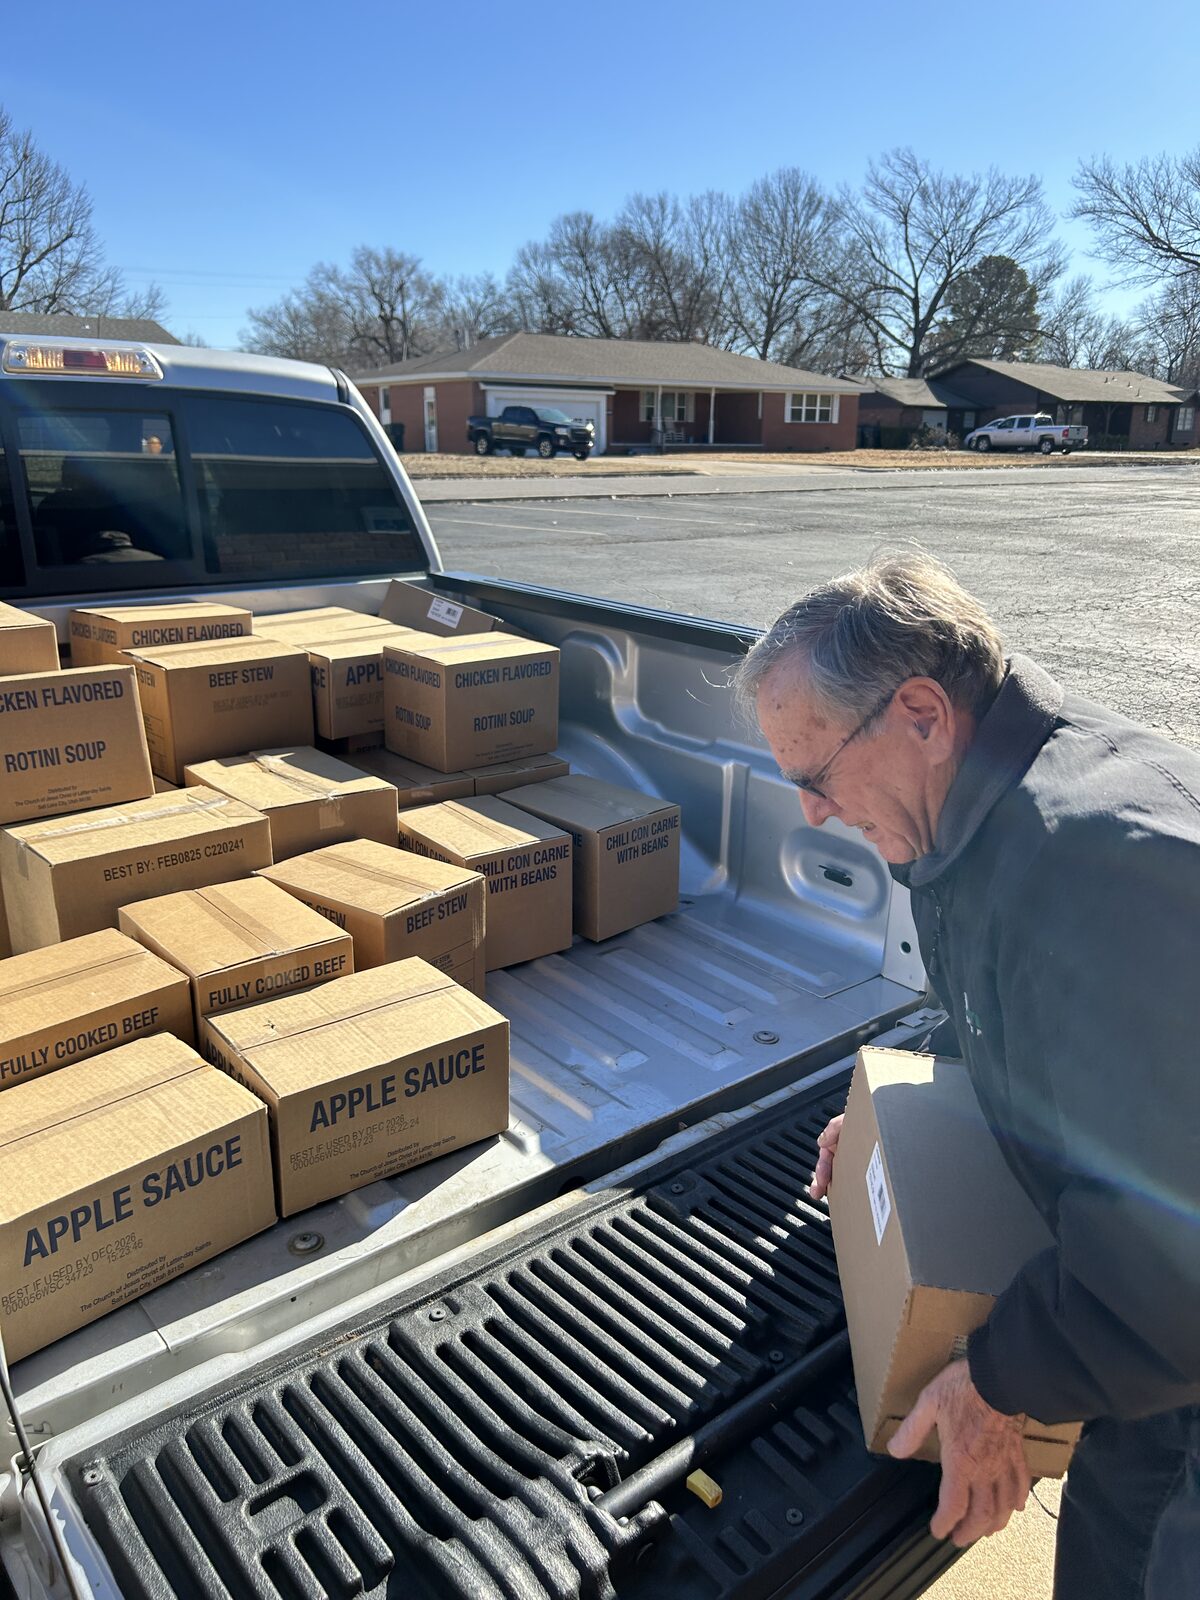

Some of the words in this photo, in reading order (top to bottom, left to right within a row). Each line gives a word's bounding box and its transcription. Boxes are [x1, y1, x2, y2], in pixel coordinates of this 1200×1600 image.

[71, 621, 91, 640] CHICKEN
[132, 627, 184, 646] CHICKEN
[187, 623, 243, 641] FLAVORED
[209, 671, 238, 688] BEEF
[242, 666, 274, 684] STEW
[346, 662, 384, 687] APPL
[385, 658, 409, 679] CHICKEN
[410, 665, 441, 688] FLAVORED
[455, 670, 499, 688] CHICKEN
[502, 661, 551, 682] FLAVORED
[42, 680, 124, 707] FLAVORED
[395, 705, 415, 725] ROTINI
[416, 713, 432, 732] SOUP
[474, 713, 507, 732] ROTINI
[509, 708, 535, 725] SOUP
[5, 748, 61, 773] ROTINI
[65, 741, 107, 764] SOUP
[606, 832, 629, 851] CHILI
[631, 824, 650, 842] CON
[651, 814, 679, 836] CARNE
[103, 864, 132, 882] BEST
[137, 860, 156, 875] BY:
[157, 850, 202, 869] FEB0825
[204, 838, 244, 858] C220241
[475, 859, 504, 877] CHILI
[507, 853, 530, 871] CON
[533, 844, 569, 865] CARNE
[616, 847, 638, 865] WITH
[640, 838, 669, 857] BEANS
[489, 873, 517, 894] WITH
[521, 865, 557, 886] BEANS
[406, 911, 434, 934] BEEF
[438, 893, 468, 921] STEW
[208, 982, 250, 1007] FULLY
[255, 964, 310, 994] COOKED
[314, 955, 346, 977] BEEF
[0, 1046, 49, 1079] FULLY
[54, 1022, 118, 1059] COOKED
[122, 1007, 159, 1034] BEEF
[310, 1075, 397, 1133] APPLE
[404, 1044, 486, 1098] SAUCE
[290, 1149, 313, 1164] BEST
[315, 1143, 324, 1154] IF
[326, 1134, 350, 1150] USED
[352, 1130, 365, 1141] BY
[366, 1121, 384, 1135] DEC
[24, 1185, 133, 1267] APPLE
[142, 1135, 242, 1207] SAUCE
[1, 1284, 30, 1307] BEST
[33, 1279, 42, 1291] IF
[44, 1264, 73, 1284] USED
[76, 1255, 90, 1271] BY
[92, 1244, 113, 1261] DEC
[114, 1232, 136, 1251] 2026
[80, 1303, 92, 1312] The
[93, 1291, 115, 1306] Church
[123, 1278, 140, 1290] Jesus
[141, 1269, 158, 1280] Christ
[124, 1287, 138, 1299] Lake
